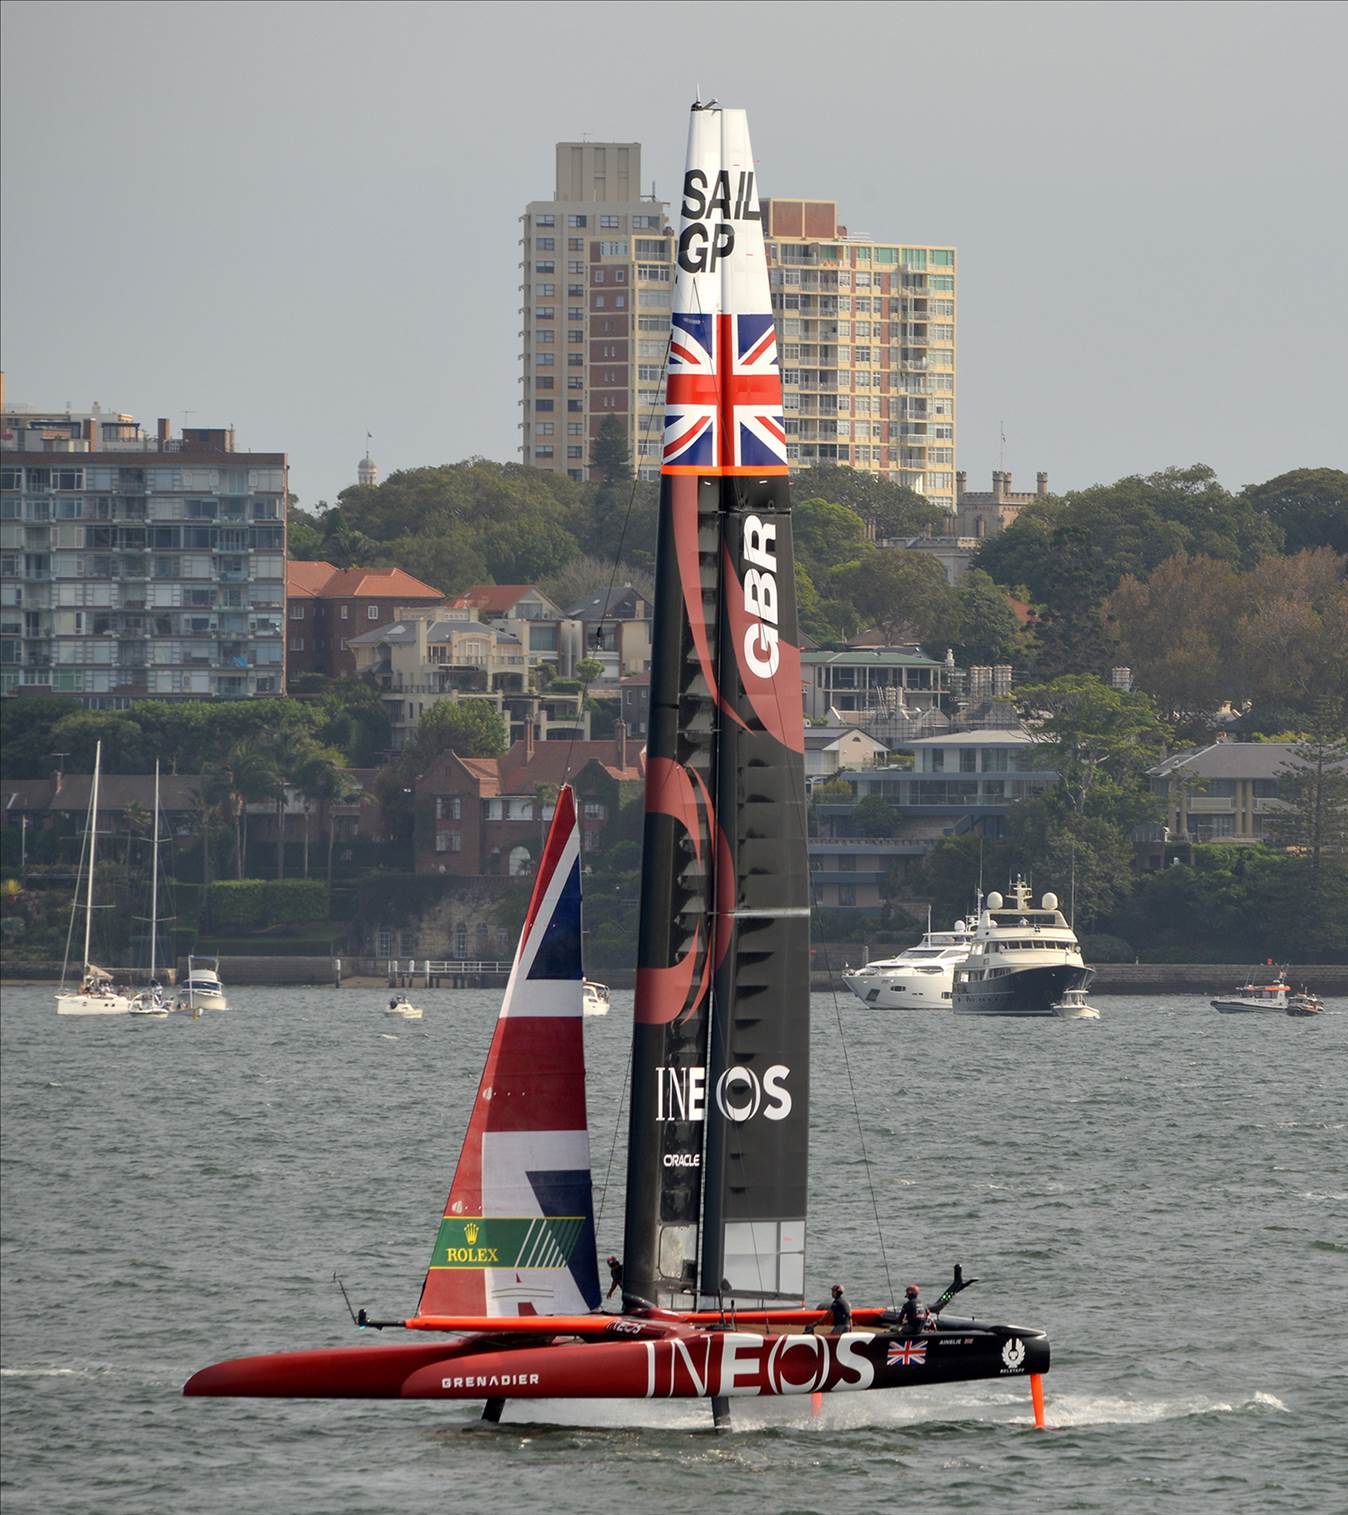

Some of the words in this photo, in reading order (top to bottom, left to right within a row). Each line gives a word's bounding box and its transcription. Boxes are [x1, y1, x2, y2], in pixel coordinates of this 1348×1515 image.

[680, 168, 761, 221] SAIL
[677, 223, 735, 275] GP
[743, 513, 780, 679] GBR
[655, 1064, 793, 1122] INEOS
[663, 1153, 700, 1168] ORACLE
[446, 1247, 500, 1263] ROLEX
[441, 1373, 540, 1389] GRENADIER
[646, 1332, 877, 1399] INEOS
